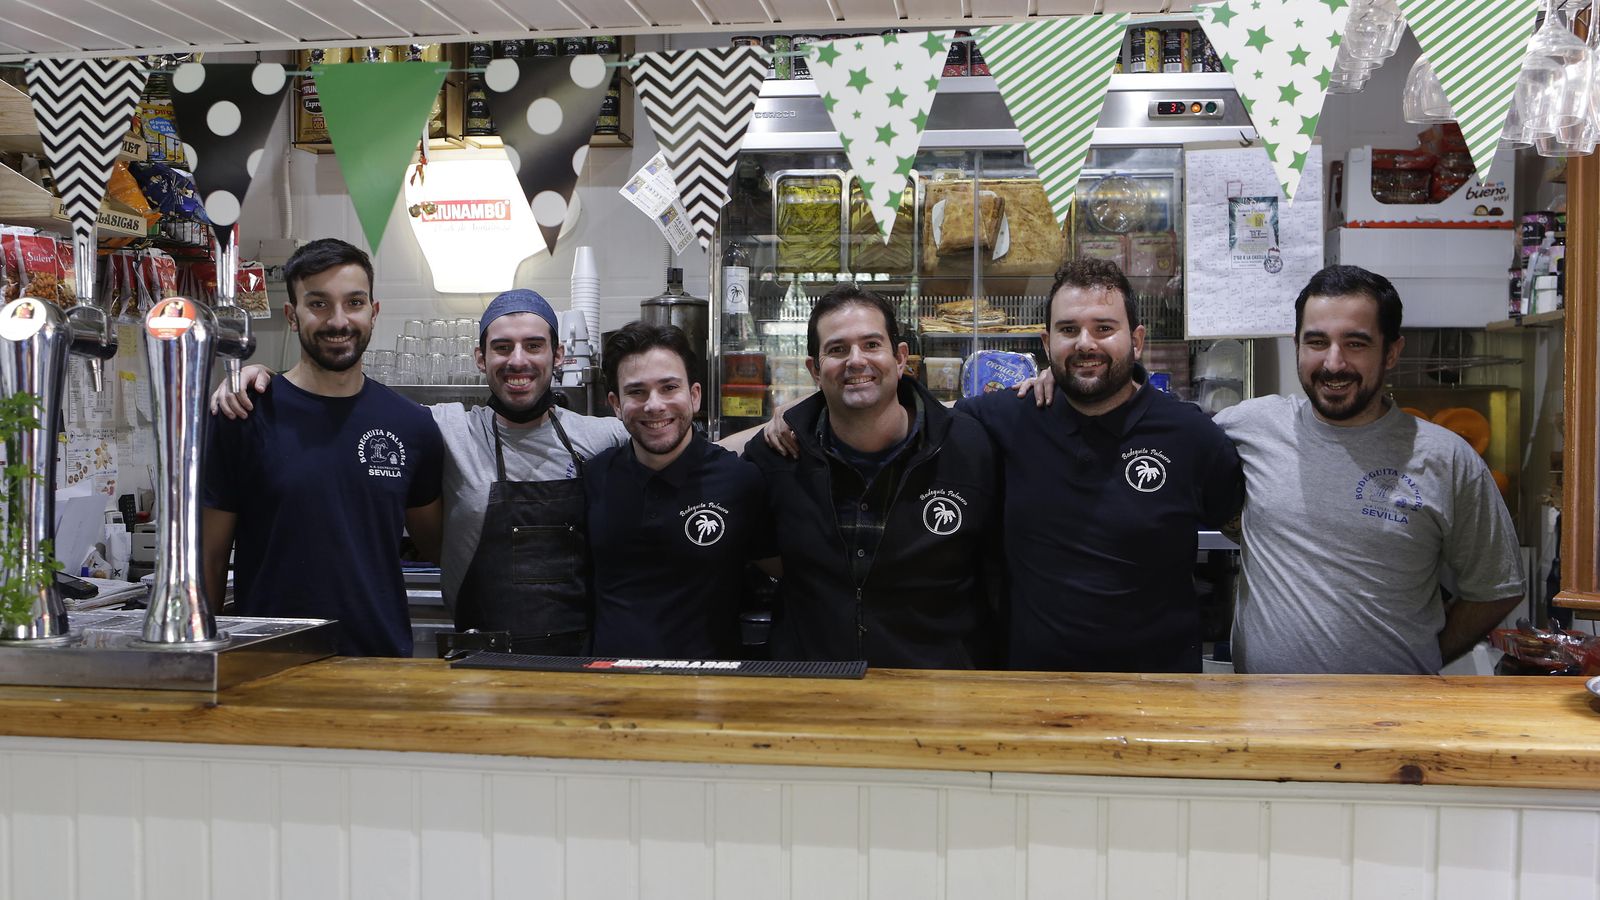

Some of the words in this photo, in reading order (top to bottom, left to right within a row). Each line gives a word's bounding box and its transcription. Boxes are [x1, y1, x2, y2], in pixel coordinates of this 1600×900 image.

[1170, 103, 1177, 113] 3
[1466, 187, 1506, 200] bueno
[358, 429, 385, 464] BODEGUITA
[386, 431, 406, 466] PALMERA
[368, 468, 402, 478] SEVILLA
[1355, 468, 1398, 500] BODEGUITA
[1361, 507, 1409, 525] SEVILLA
[611, 659, 742, 669] DESPERADOS
